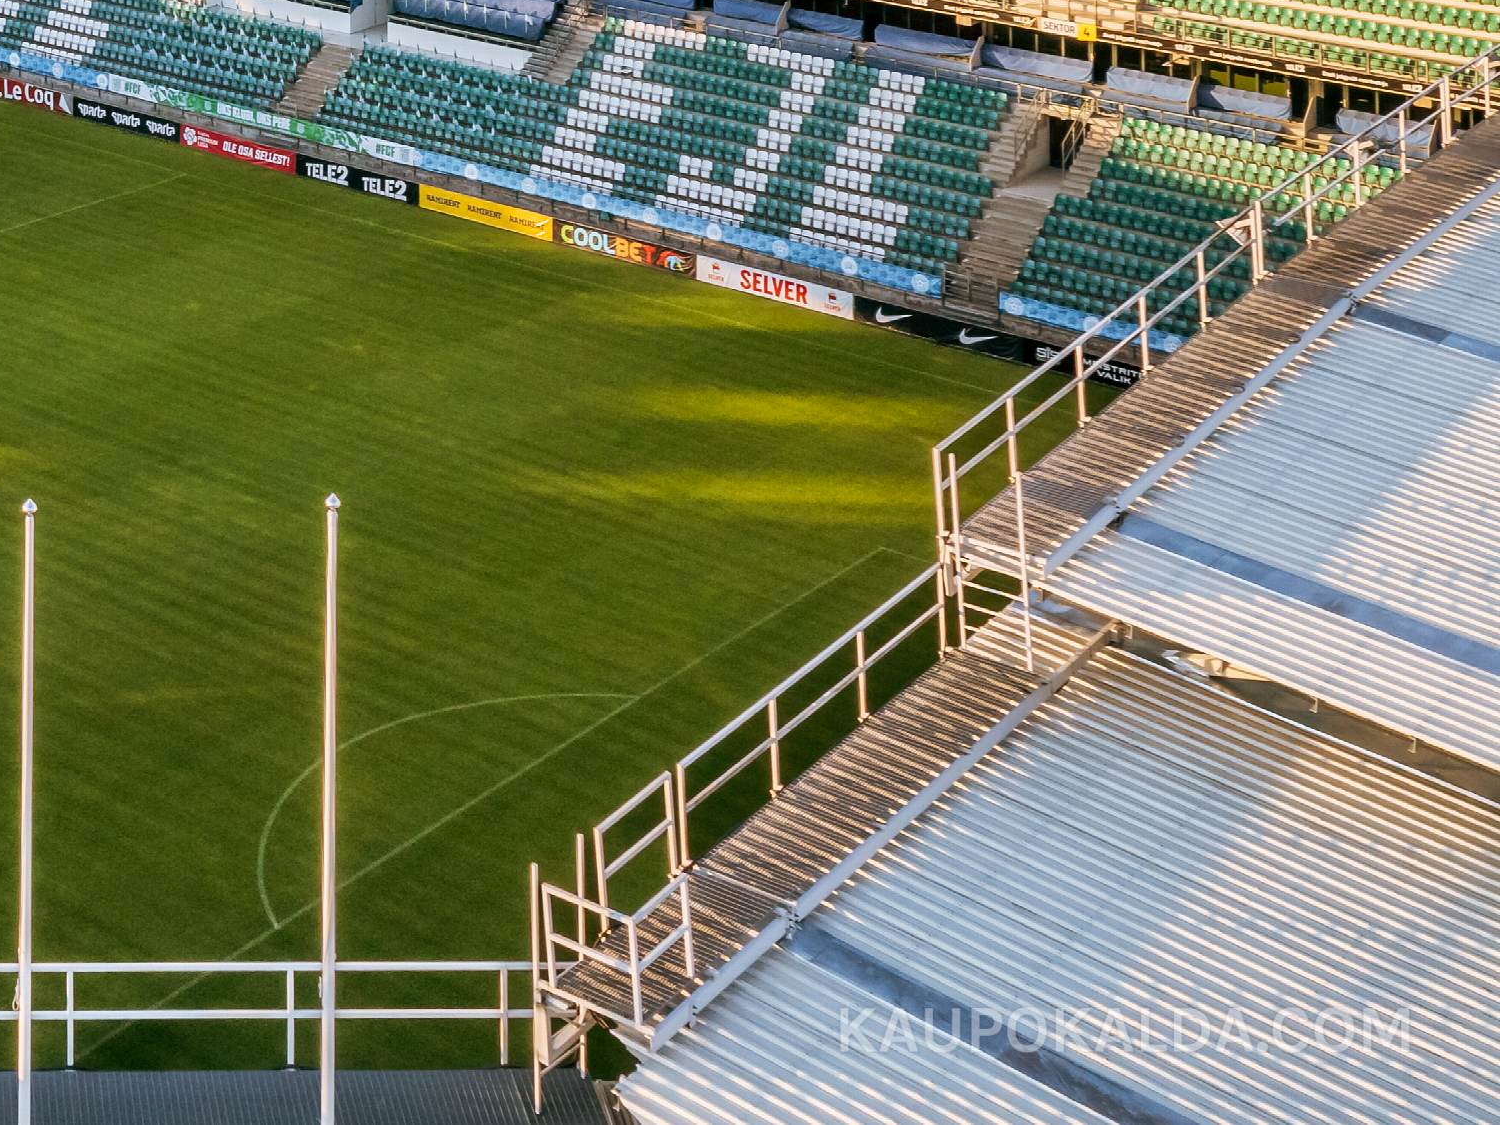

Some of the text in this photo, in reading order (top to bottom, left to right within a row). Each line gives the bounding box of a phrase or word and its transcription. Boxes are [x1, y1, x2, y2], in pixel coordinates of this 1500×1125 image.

[1043, 21, 1076, 34] SEKTOR
[1083, 27, 1090, 36] 4
[24, 82, 54, 110] Coq
[77, 102, 106, 119] sparta
[111, 111, 141, 128] sparta
[145, 120, 176, 136] sparta
[222, 141, 290, 167] OLE OSA SELLEST!
[305, 162, 349, 187] TELE2
[361, 176, 407, 202] TELE2
[426, 194, 461, 209] RAMIRENT
[467, 204, 503, 220] RAMIRENT
[560, 225, 657, 264] COOLBET
[740, 269, 808, 304] SELVER
